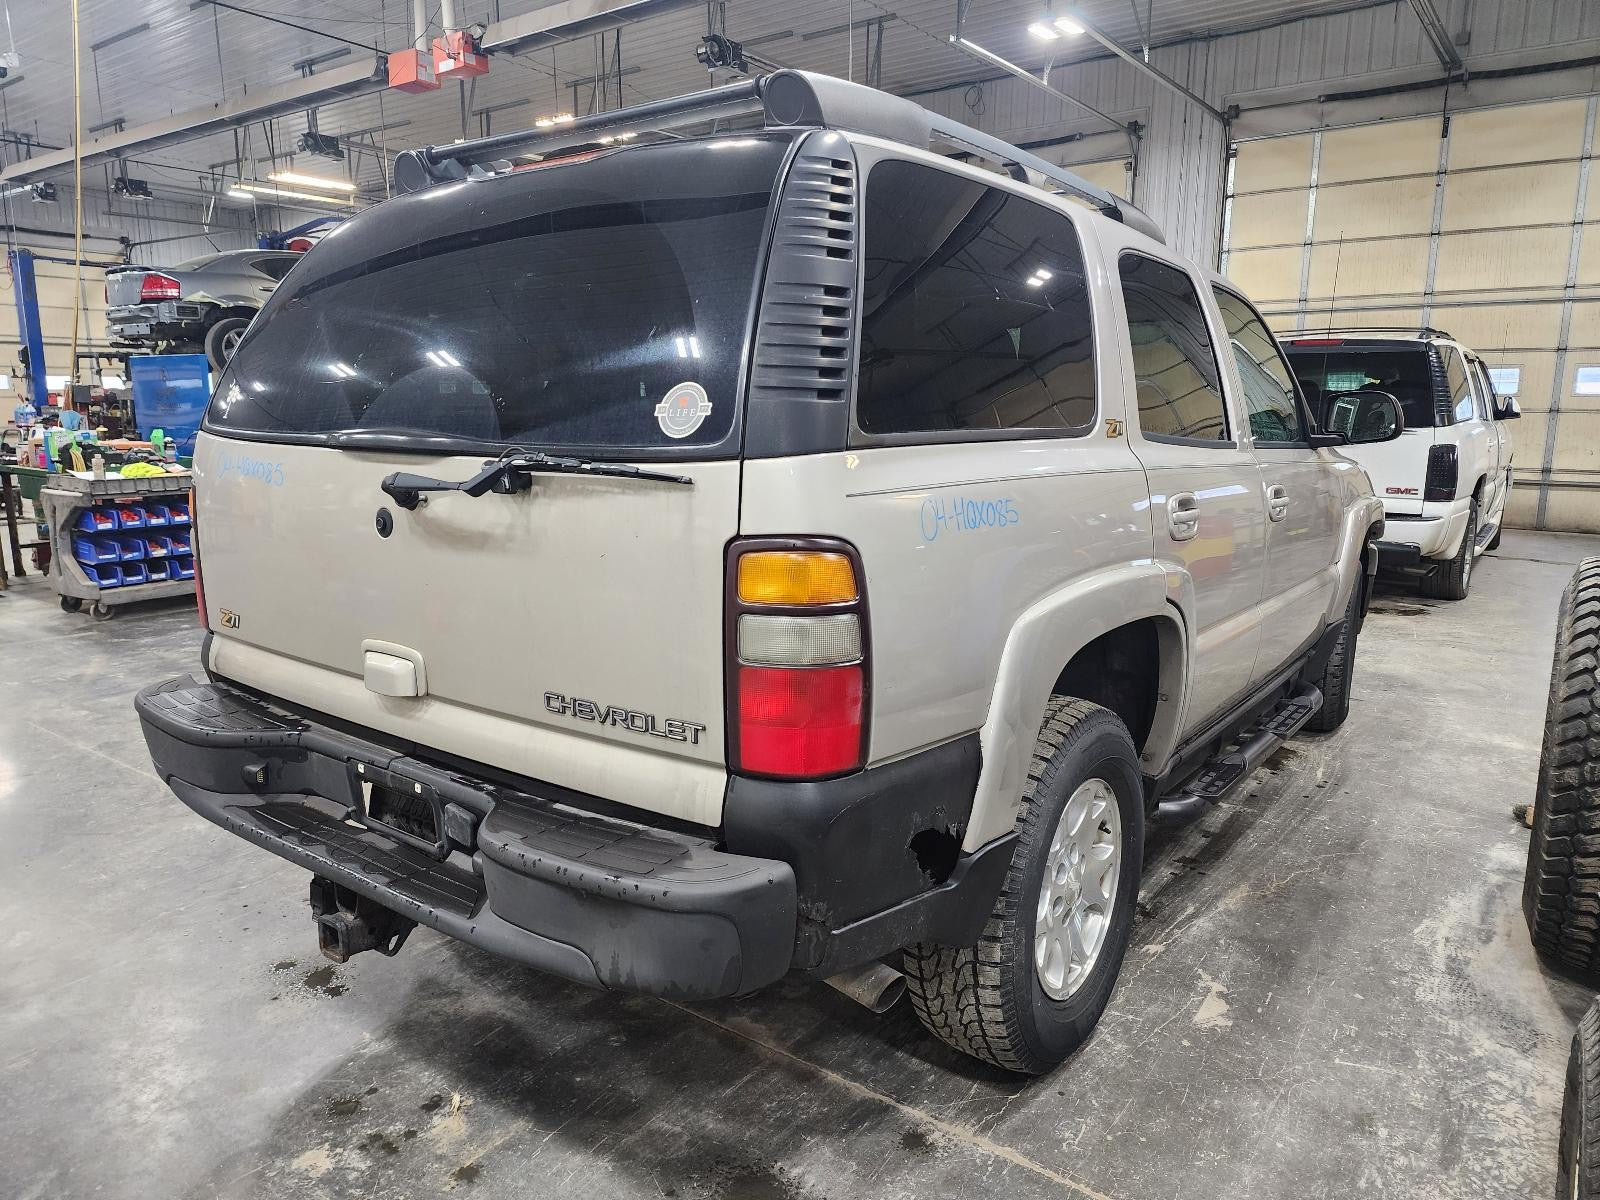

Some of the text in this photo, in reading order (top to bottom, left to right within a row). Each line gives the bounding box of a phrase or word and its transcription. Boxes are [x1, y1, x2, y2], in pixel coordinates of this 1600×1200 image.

[669, 408, 697, 417] LIFE
[1386, 487, 1418, 495] GMC
[544, 691, 706, 744] CHEVROLET
